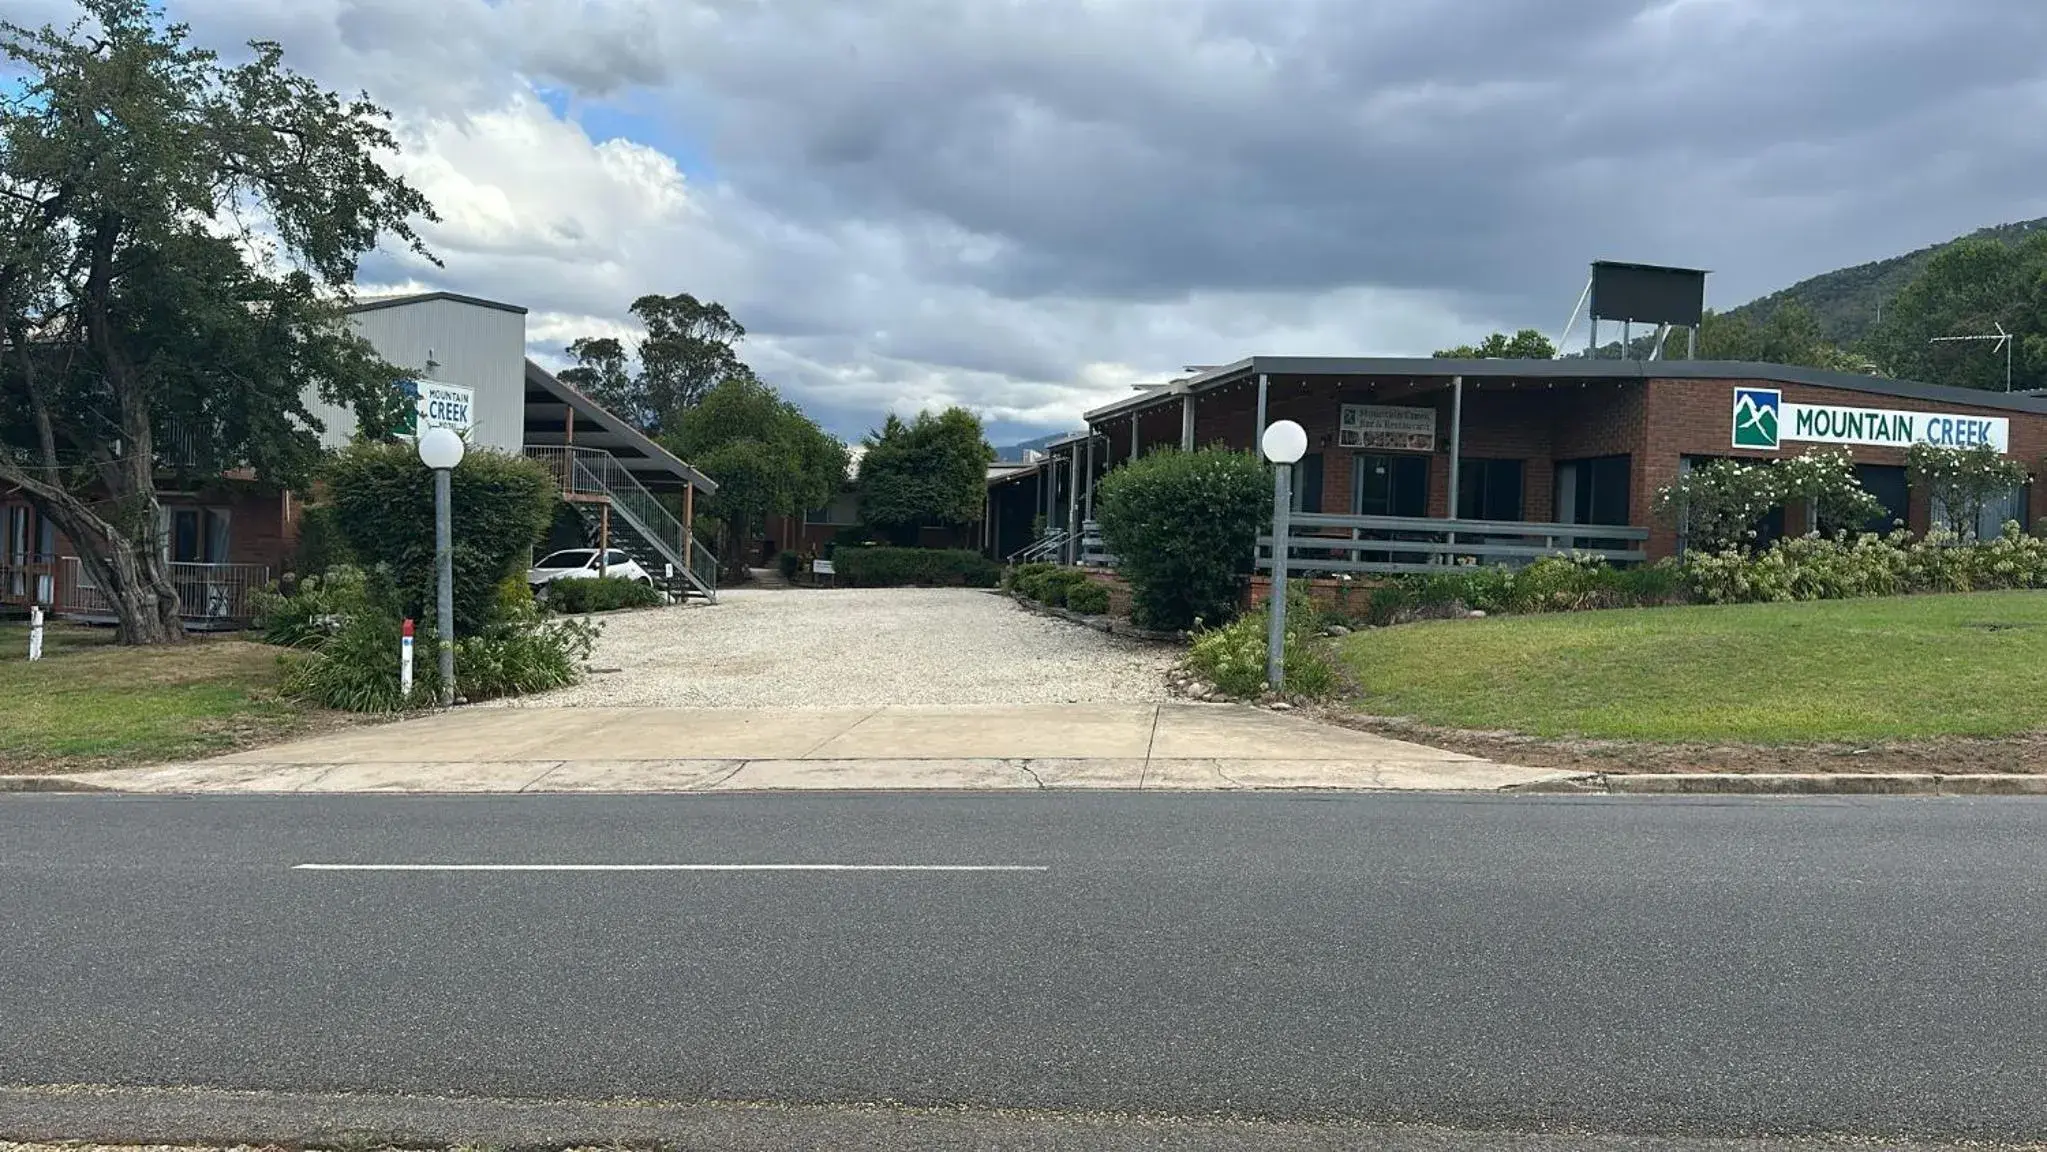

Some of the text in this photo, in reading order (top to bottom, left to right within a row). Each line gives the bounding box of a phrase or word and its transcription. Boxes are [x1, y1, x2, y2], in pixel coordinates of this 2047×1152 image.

[429, 389, 469, 403] MOUNTAIN
[429, 400, 468, 423] CREEK
[1796, 409, 1992, 447] MOUNTAIN CREEK
